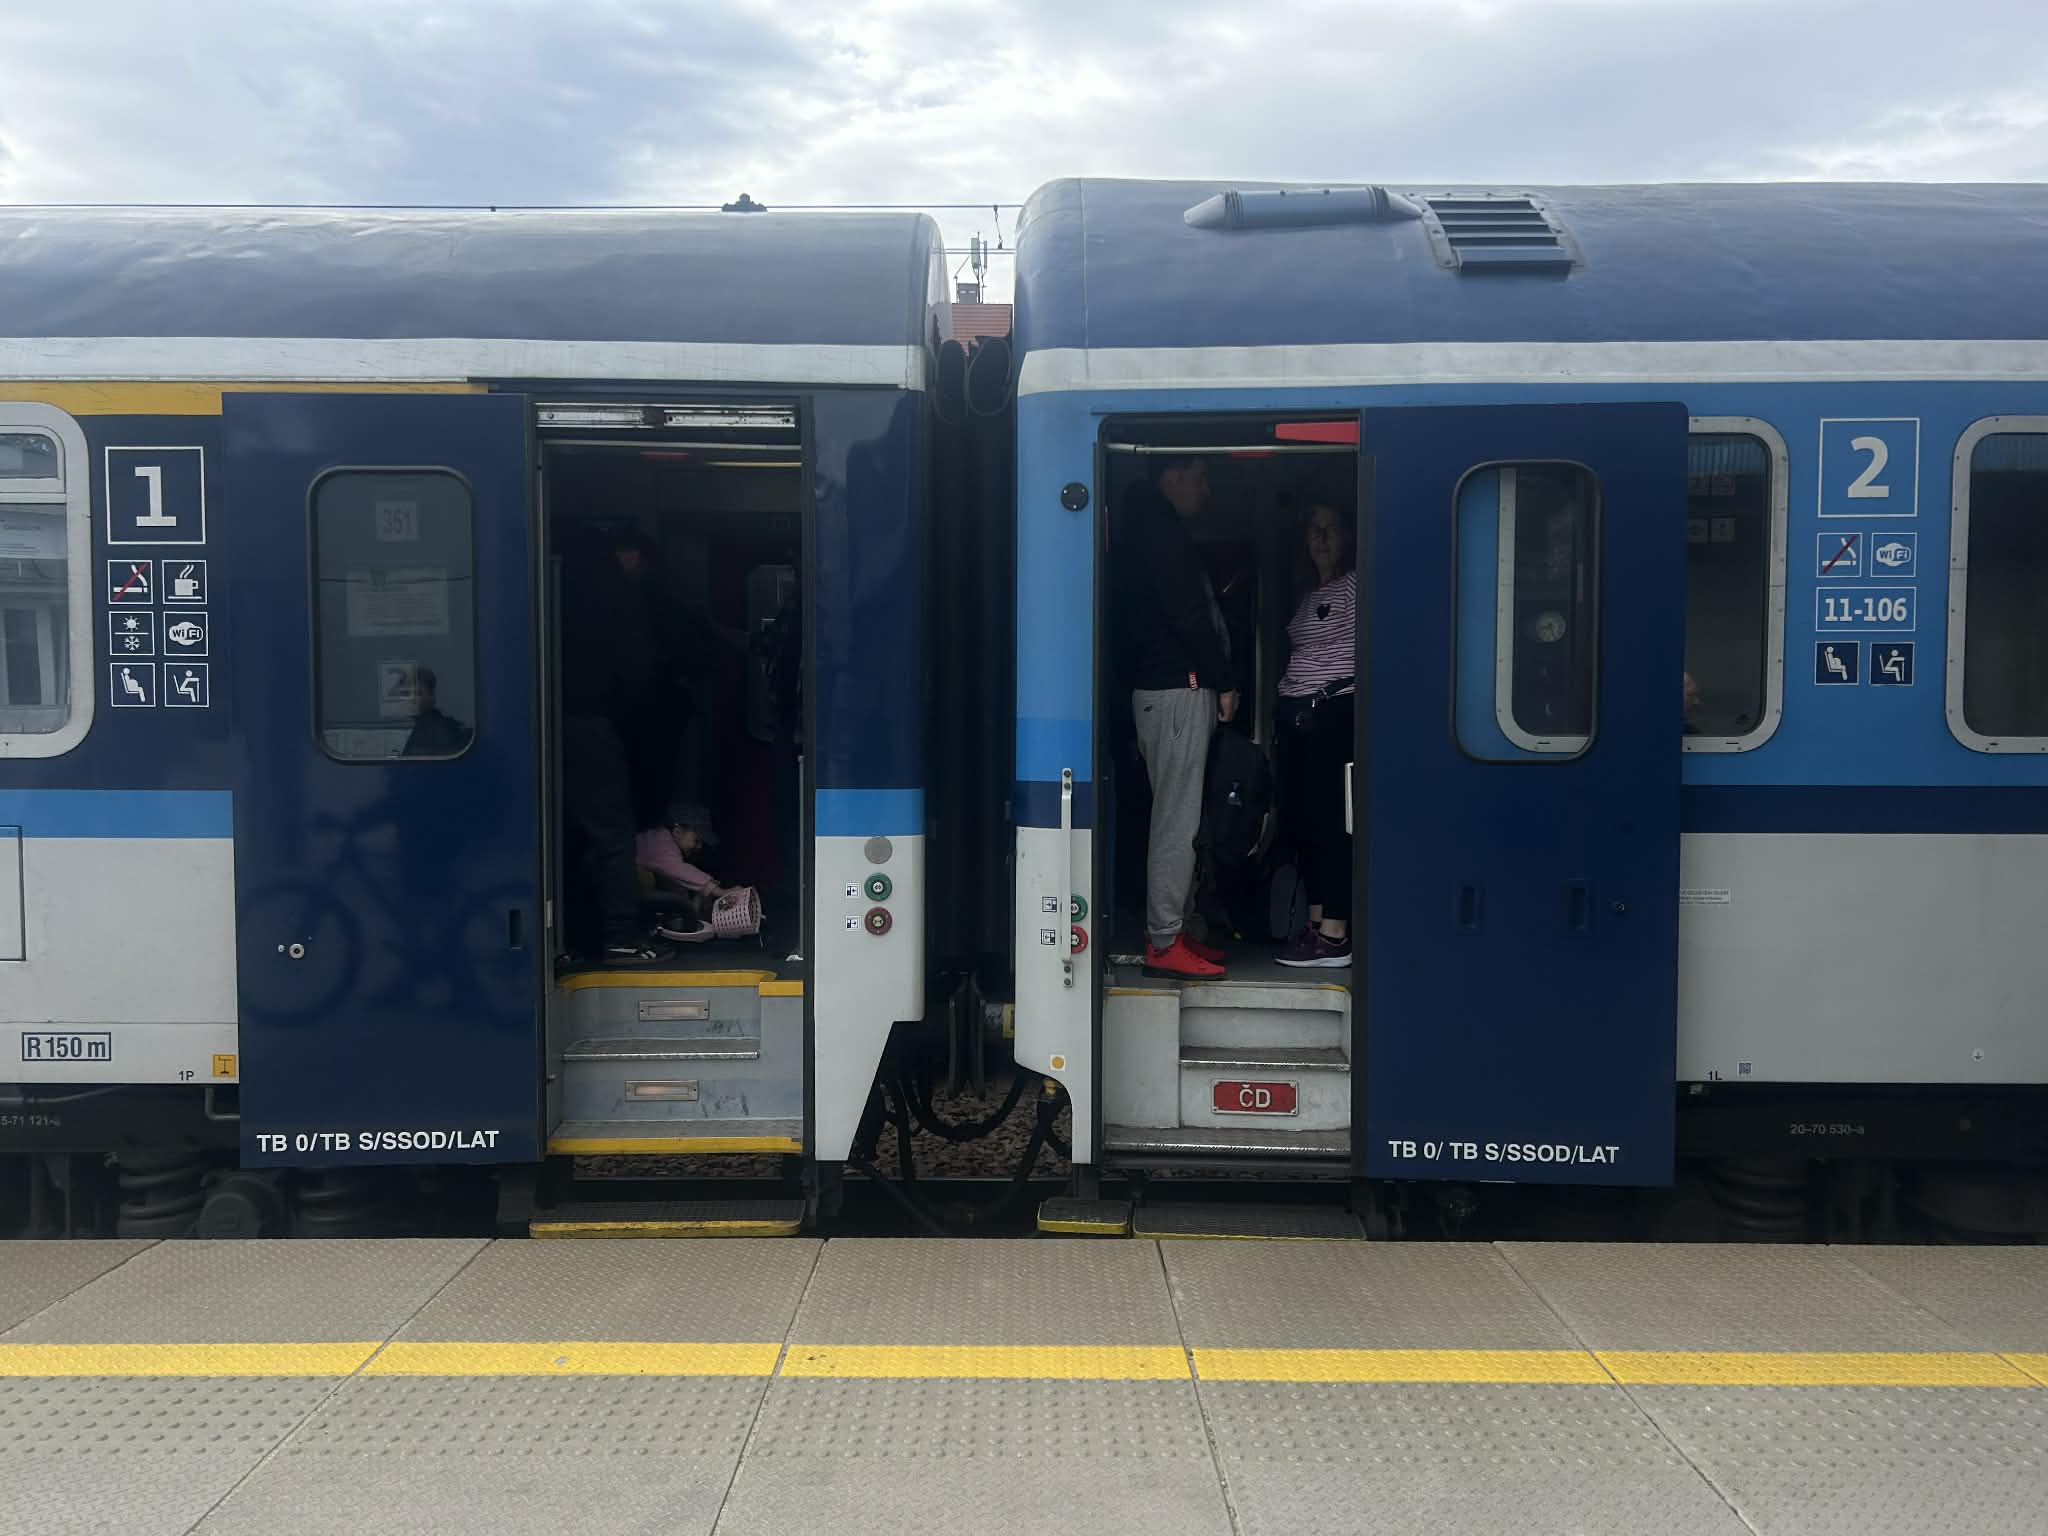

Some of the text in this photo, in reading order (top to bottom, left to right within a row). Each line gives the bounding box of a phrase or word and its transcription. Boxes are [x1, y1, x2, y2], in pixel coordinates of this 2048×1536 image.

[1847, 436, 1890, 498] 2
[134, 466, 177, 527] 1
[1824, 597, 1907, 622] 11-106
[27, 1036, 106, 1058] R 150 m
[178, 1070, 195, 1081] 1P
[1707, 1070, 1723, 1081] 1L
[1238, 1084, 1271, 1109] ČD
[256, 1134, 288, 1153] TB
[359, 1130, 500, 1151] S/SSOD/LAT
[1388, 1140, 1417, 1158] TB
[1449, 1142, 1478, 1160] TB
[1484, 1142, 1620, 1165] S/SSOD/LAT
